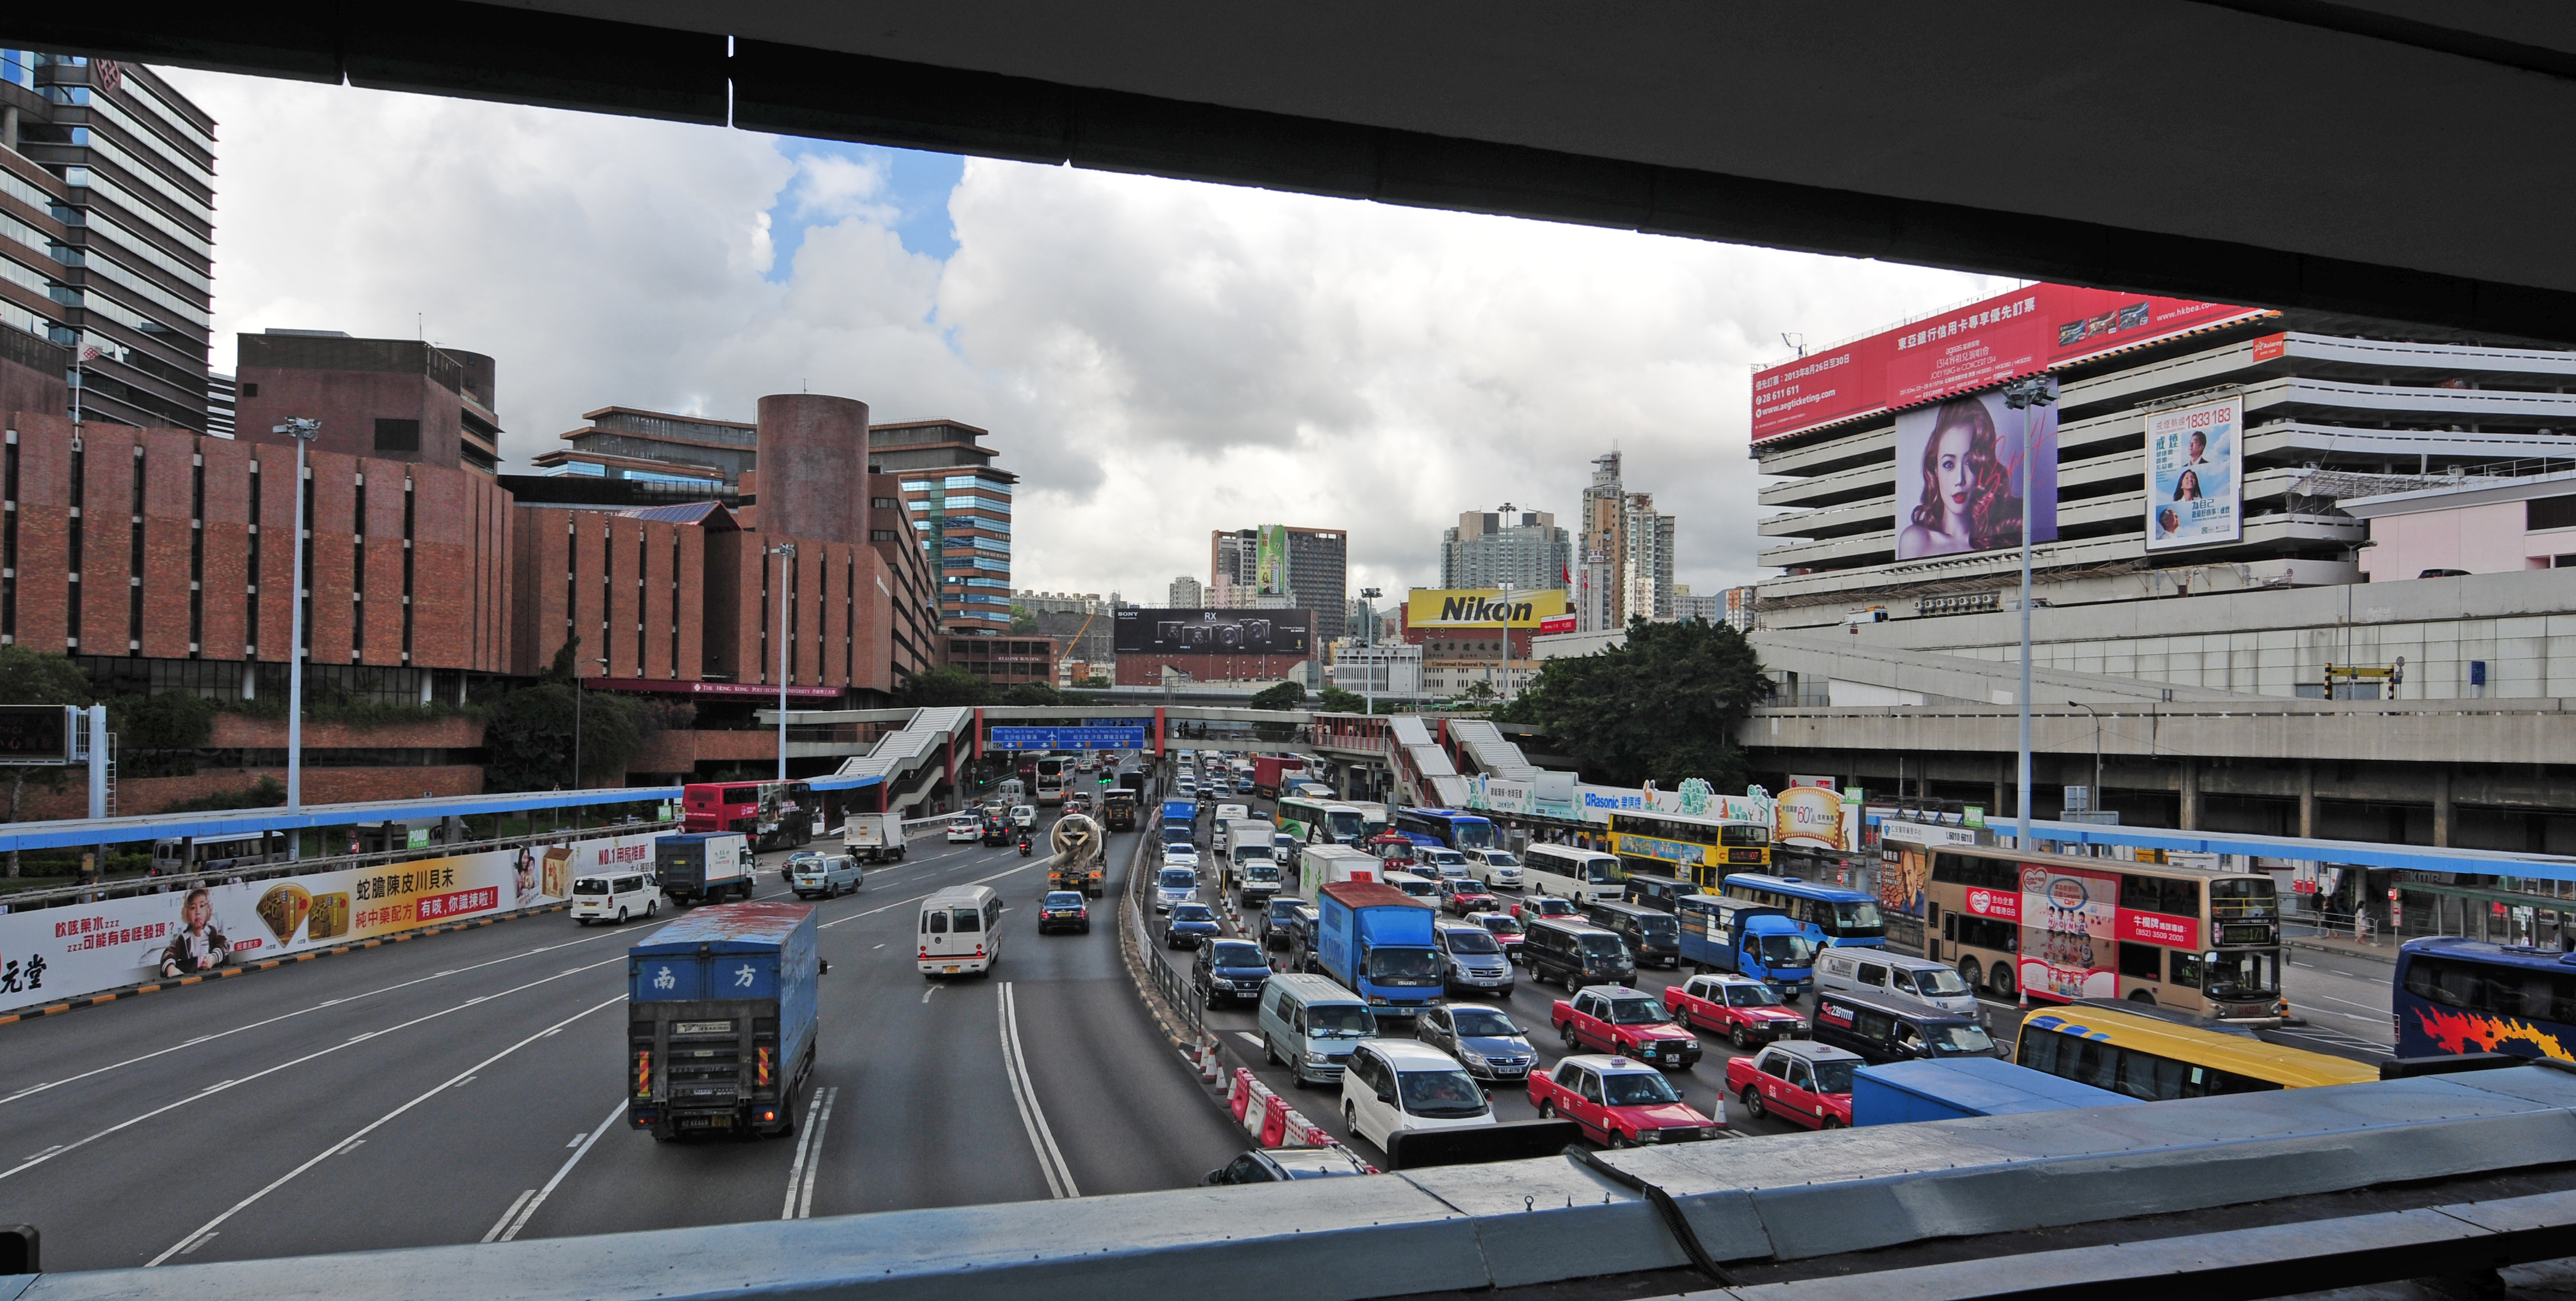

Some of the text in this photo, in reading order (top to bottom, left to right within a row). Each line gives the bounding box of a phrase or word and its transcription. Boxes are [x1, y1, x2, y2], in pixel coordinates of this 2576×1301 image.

[1898, 296, 2035, 351] 東亞銀行信用卡專享優先訂票
[1961, 358, 1986, 371] CONCERT
[1762, 384, 1800, 404] 28 611 611
[1763, 389, 1836, 416] www.aegticketing.com
[2186, 411, 2210, 429] 1833
[2212, 407, 2231, 424] 183
[2156, 433, 2178, 450] 戒煙
[2192, 498, 2214, 510] 為自己
[1204, 612, 1217, 620] RX
[1441, 596, 1533, 621] Nikon
[1591, 793, 1620, 809] Rasonic
[1845, 789, 1861, 800] POAD
[659, 807, 671, 816] POAD
[1965, 808, 1982, 822] POAD
[410, 828, 428, 843] POAD
[356, 867, 454, 901] 蛇膽陳皮川貝末
[1992, 895, 2014, 906] 全心全意
[356, 903, 413, 929] 純中藥配方
[1990, 906, 2016, 916] 給香港BB
[55, 916, 120, 938] 飲咳藥水zzz
[2133, 915, 2159, 929] 牛欄牌
[2136, 927, 2184, 942] (852) 3509 2000
[2249, 927, 2264, 940] 171
[236, 941, 260, 951] 兒童配方
[0, 954, 47, 993] 元堂
[2245, 1005, 2261, 1014] KMB
